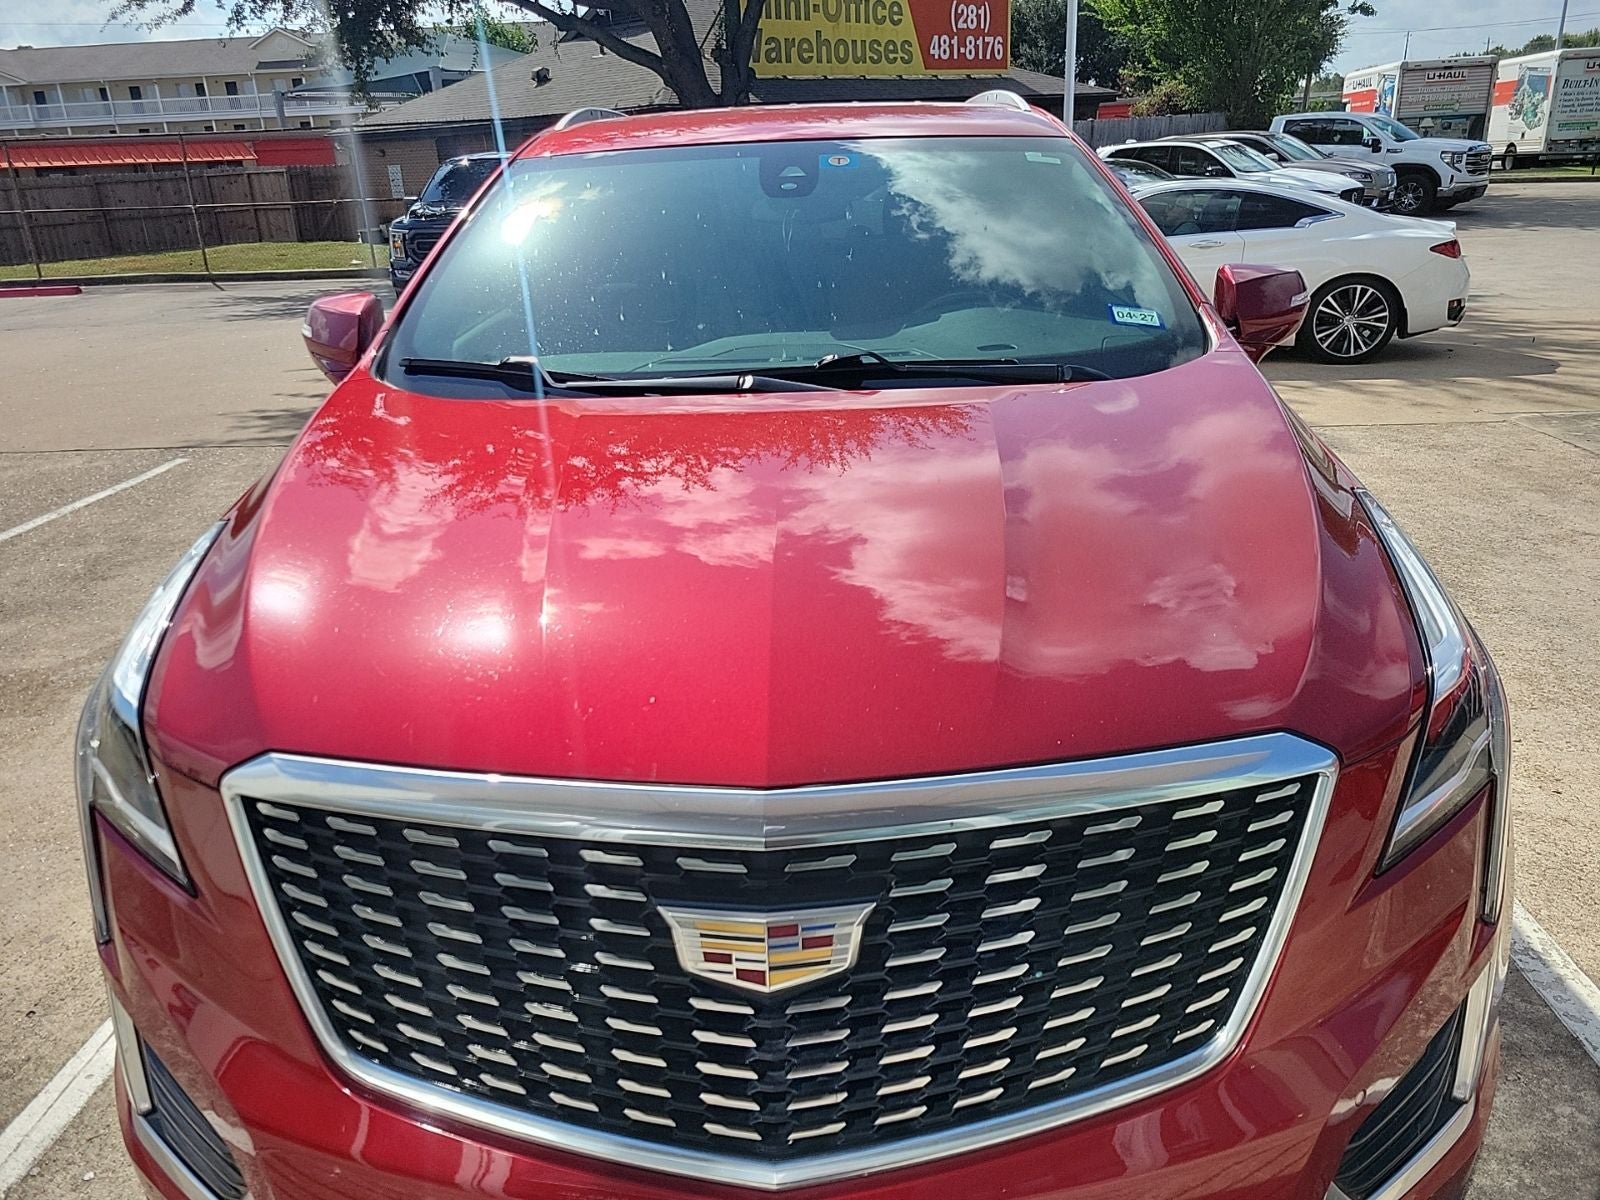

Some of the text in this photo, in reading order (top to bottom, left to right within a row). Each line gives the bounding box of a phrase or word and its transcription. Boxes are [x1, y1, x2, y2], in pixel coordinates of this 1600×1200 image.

[764, 0, 903, 26] ini-Office
[951, 0, 990, 33] (281)
[930, 35, 1003, 60] 481-8176
[1426, 71, 1466, 80] U-HAUL
